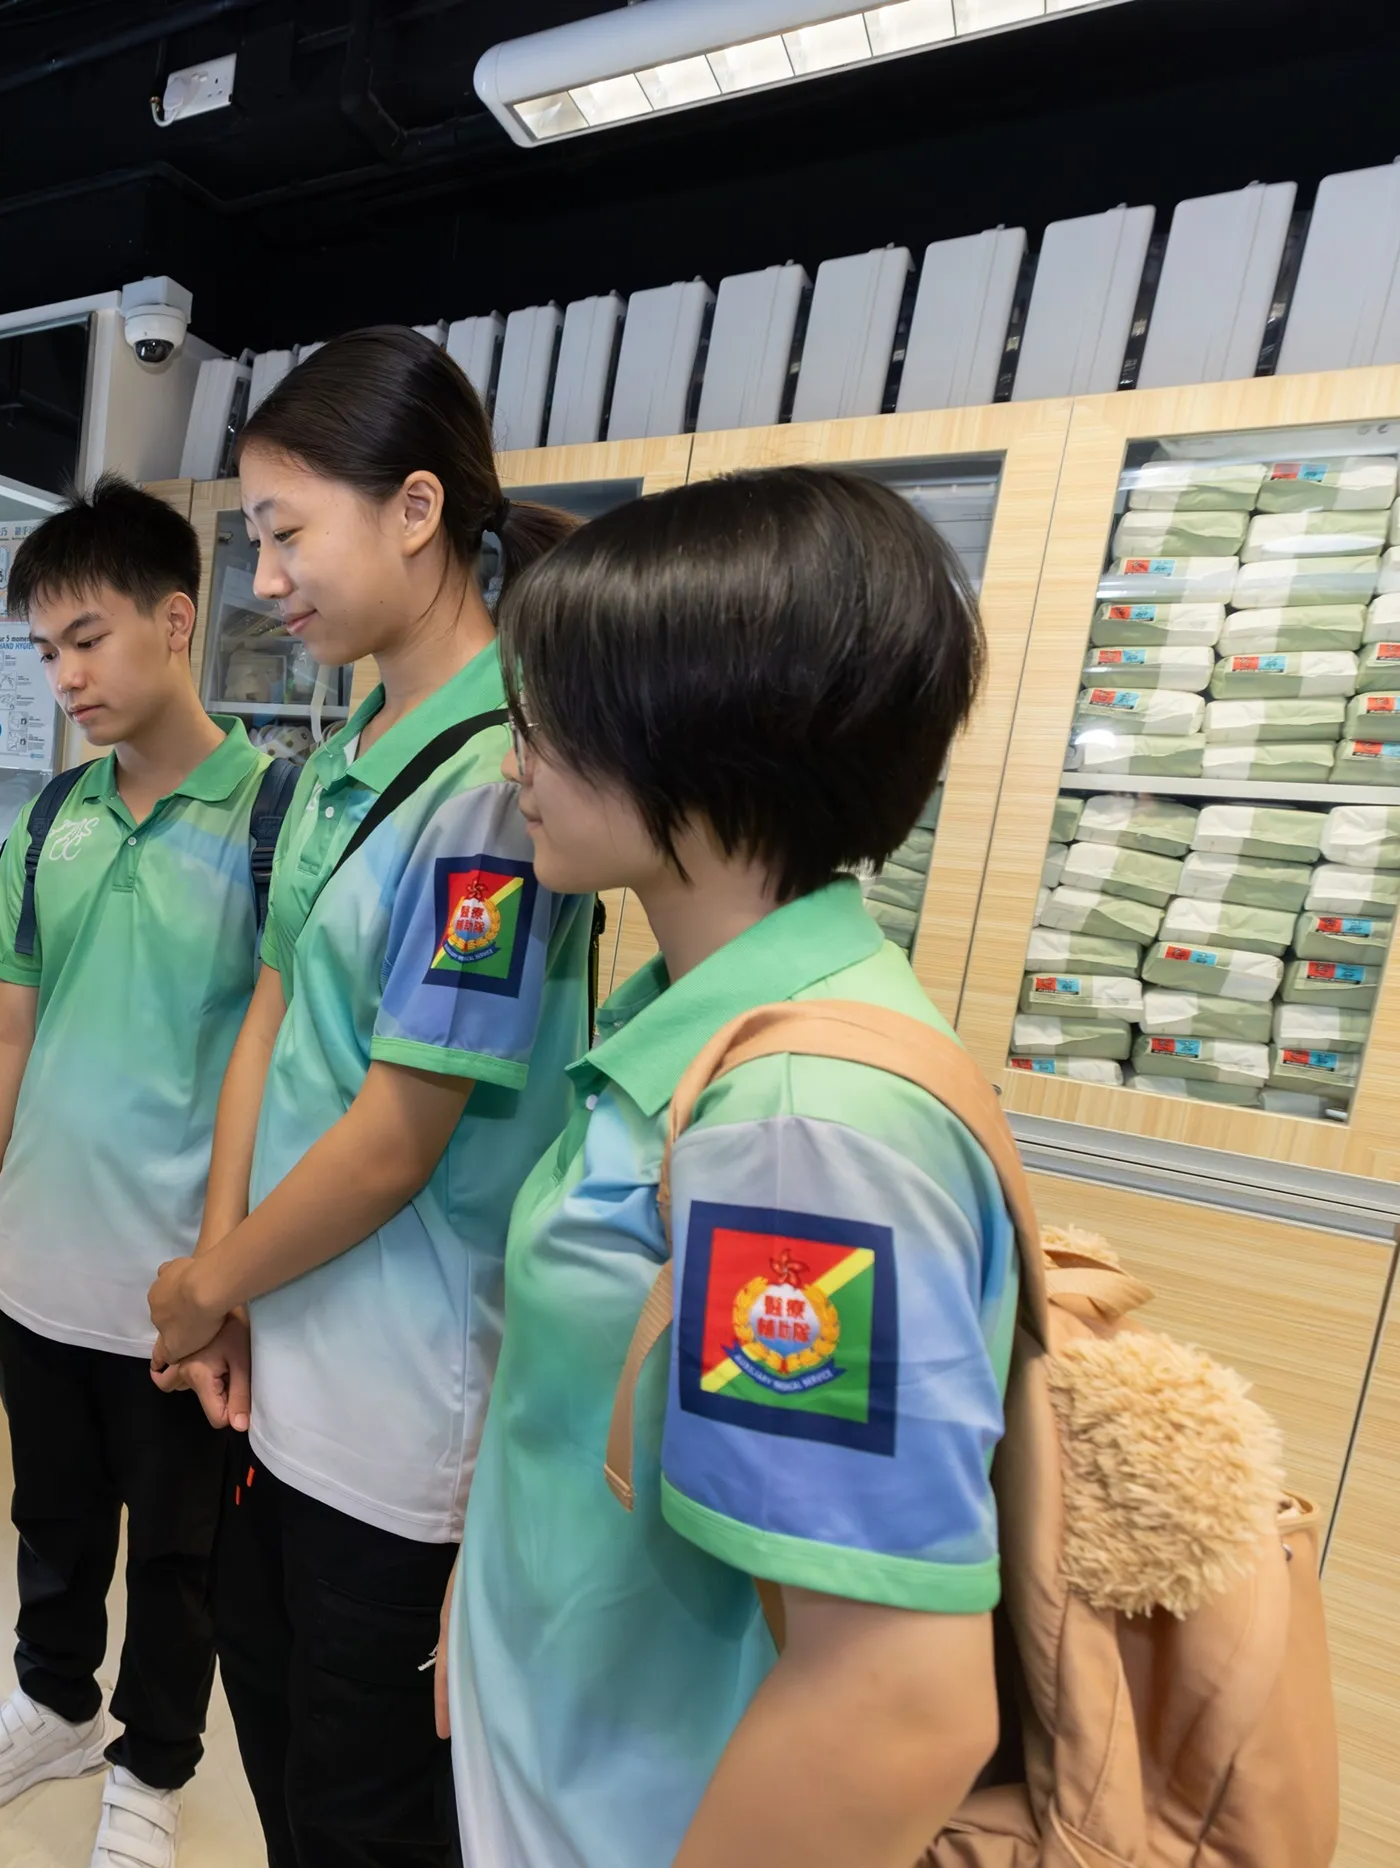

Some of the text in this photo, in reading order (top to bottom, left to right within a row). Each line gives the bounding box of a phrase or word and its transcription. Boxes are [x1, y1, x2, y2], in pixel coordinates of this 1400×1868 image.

[733, 1353, 834, 1391] AUXILIARY MEDICAL SERVICE
